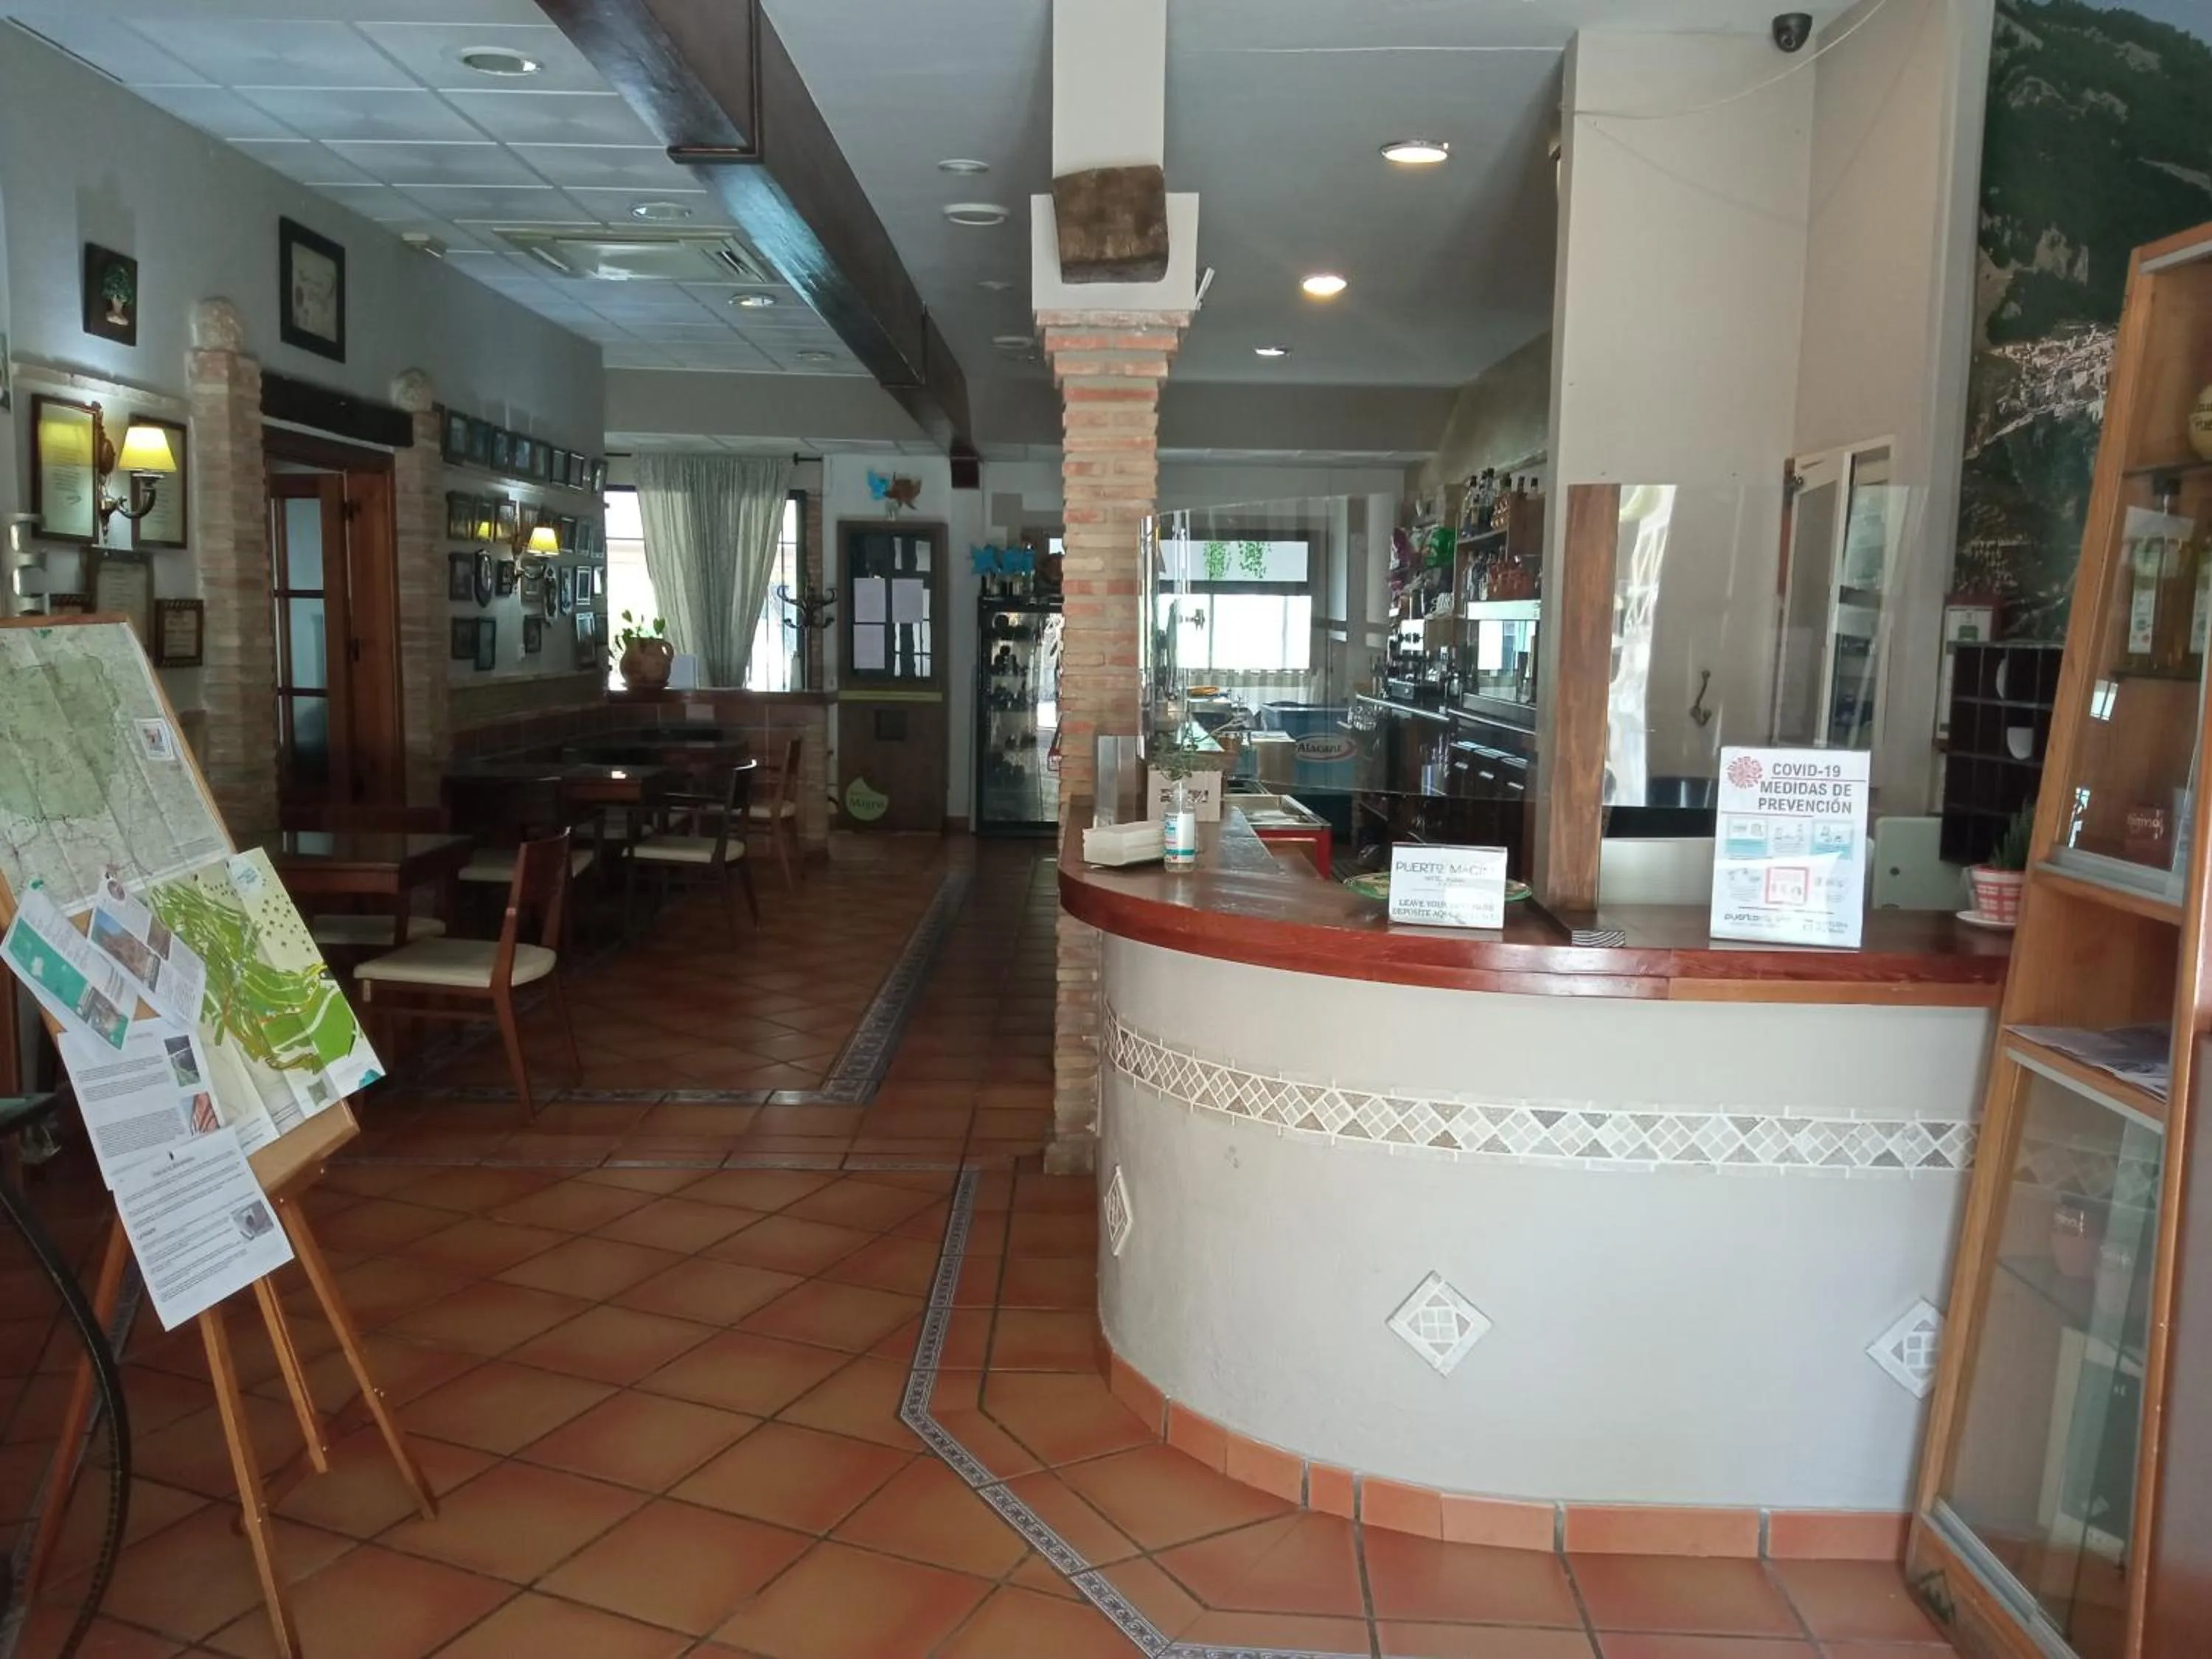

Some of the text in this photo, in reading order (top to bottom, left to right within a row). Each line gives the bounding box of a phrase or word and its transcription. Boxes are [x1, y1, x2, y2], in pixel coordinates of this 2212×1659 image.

[1772, 762, 1841, 778] COVID-19
[1760, 781, 1852, 797] MEDIDAS DE
[1758, 796, 1852, 814] PREVENCIÓN
[1396, 861, 1444, 874] PUERTO
